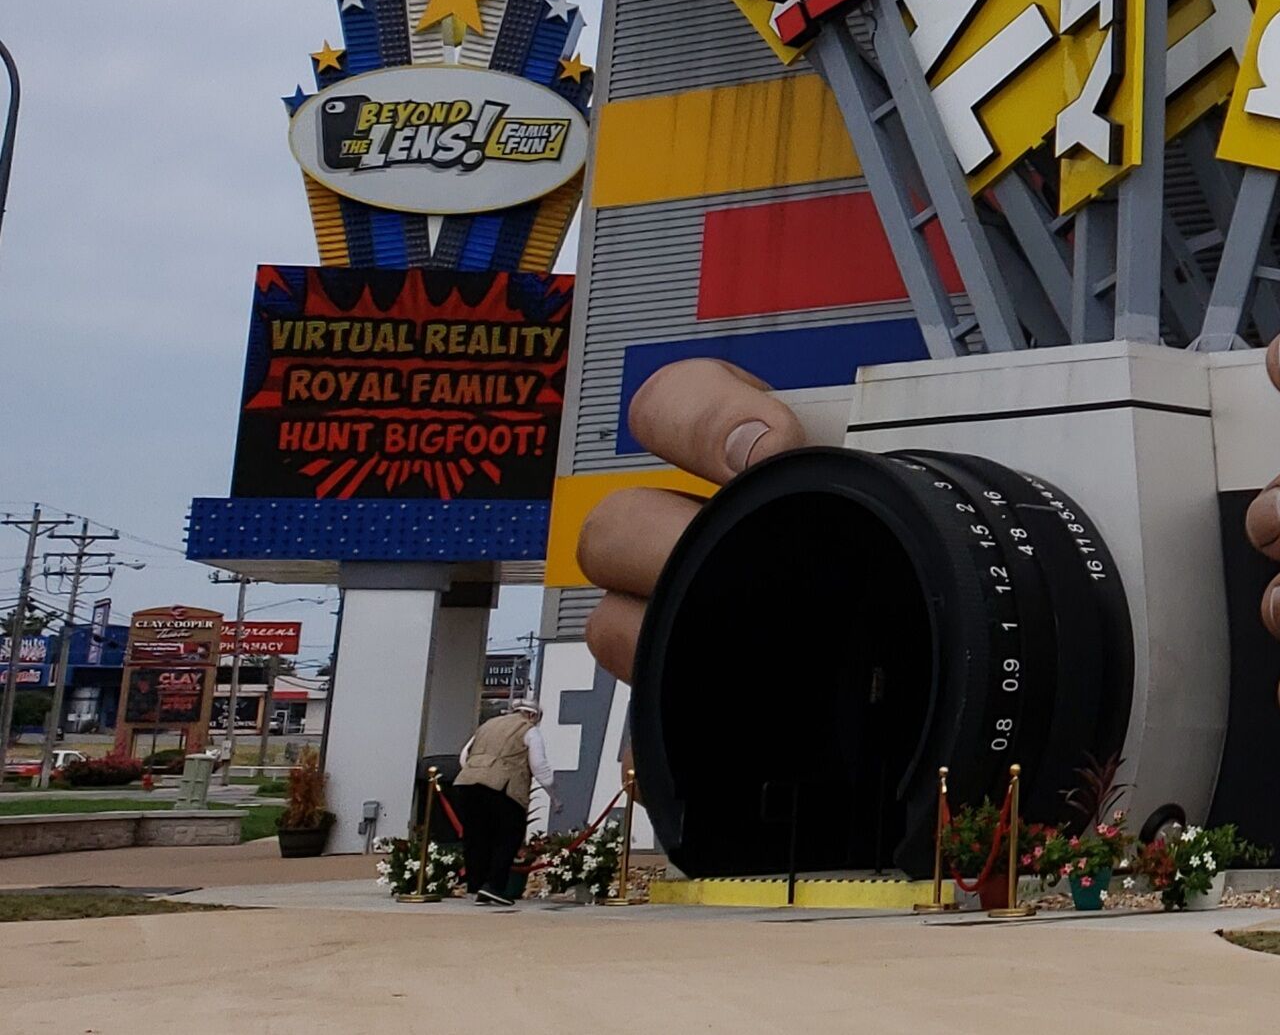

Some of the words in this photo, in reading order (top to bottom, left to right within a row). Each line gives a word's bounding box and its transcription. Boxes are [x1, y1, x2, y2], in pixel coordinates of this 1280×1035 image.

[357, 101, 472, 131] BEYOND
[341, 139, 371, 157] THE
[359, 103, 504, 167] LENS!
[500, 121, 565, 143] FAMILY
[502, 138, 547, 154] FUN
[271, 319, 413, 352] VIRTUAL
[424, 324, 564, 357] REALITY
[287, 369, 400, 401] ROYAL
[411, 373, 538, 405] FAMILY
[278, 422, 375, 451] HUNT
[384, 423, 547, 456] BIGFOOT!
[956, 502, 975, 513] 2
[983, 490, 1007, 506] 16
[970, 524, 996, 549] 1.5
[1067, 523, 1084, 533] 8
[1018, 544, 1034, 556] 4
[1075, 538, 1096, 554] 11
[990, 566, 1011, 594] 1.2
[1086, 559, 1106, 580] 16
[135, 620, 166, 628] CLAY
[167, 620, 213, 628] COOPER
[1001, 621, 1018, 631] 1
[218, 641, 284, 651] PHRMACY
[159, 672, 202, 684] CLAY
[1001, 658, 1020, 692] 0.9
[990, 718, 1013, 751] 0.8
